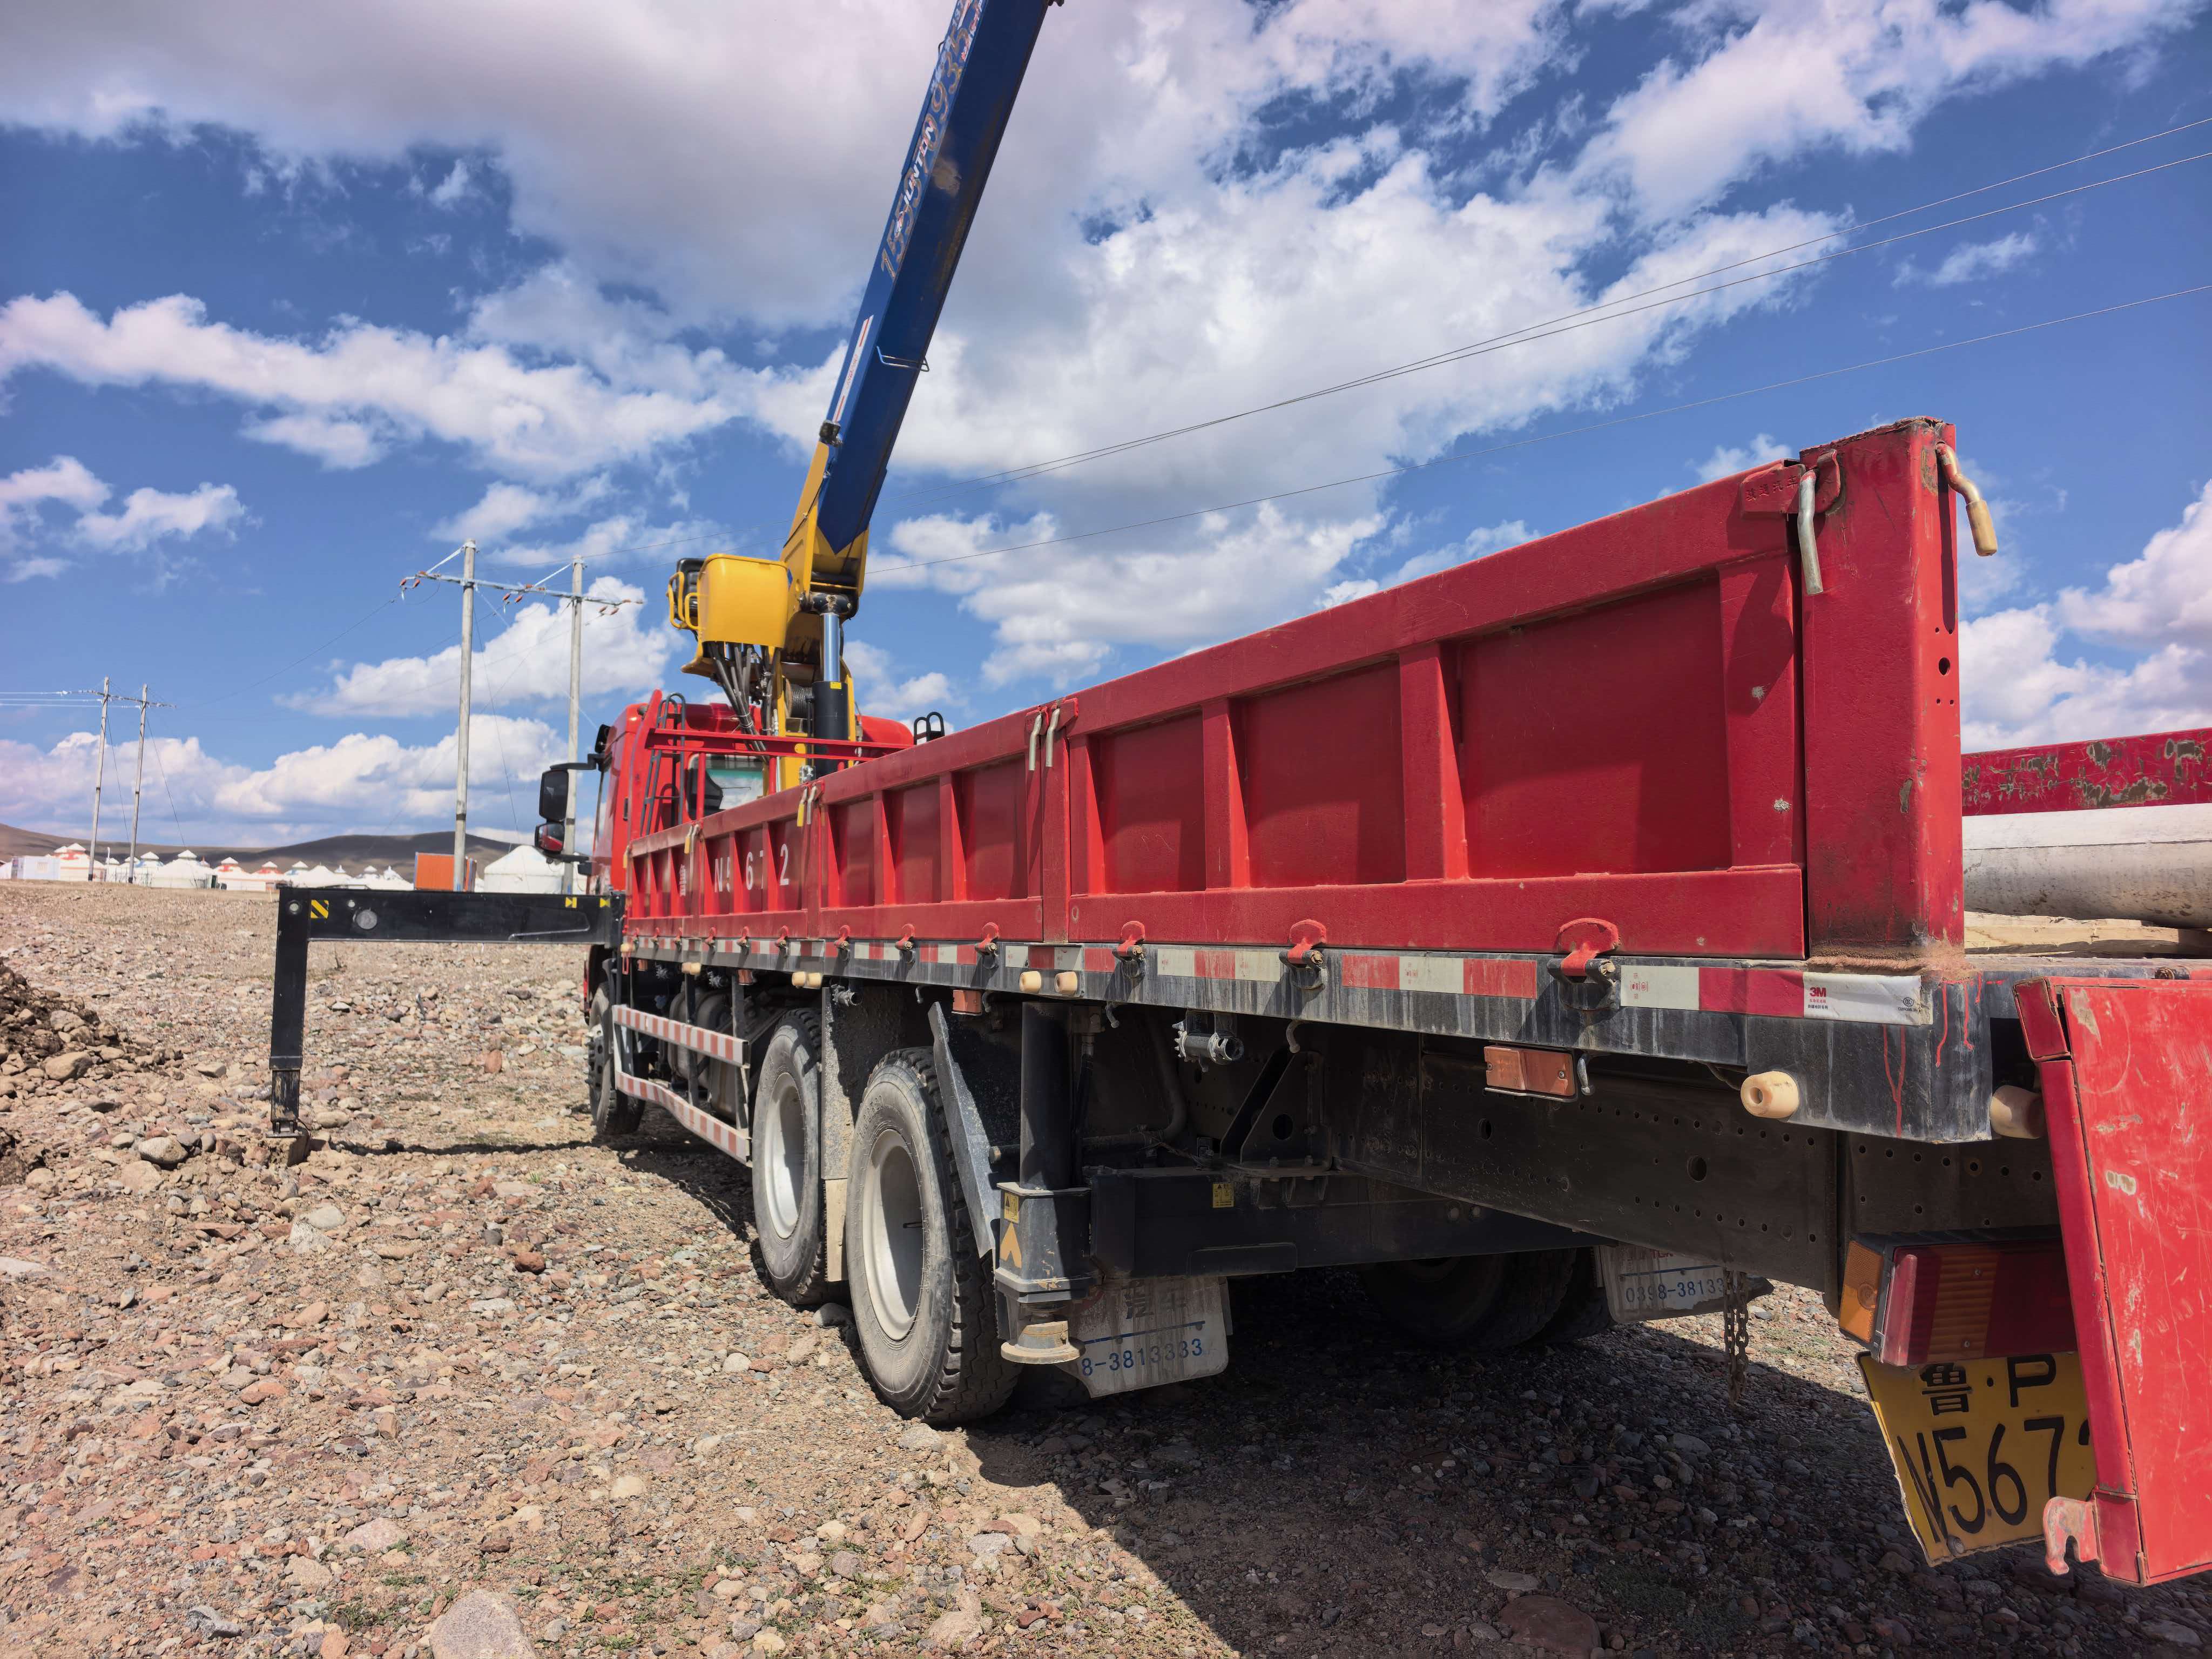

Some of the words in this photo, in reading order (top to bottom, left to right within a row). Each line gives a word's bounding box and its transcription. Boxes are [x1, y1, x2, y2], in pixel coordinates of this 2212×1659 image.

[1810, 987, 1826, 997] 3M
[1625, 1277, 1738, 1303] 0398-38133
[1896, 1416, 2090, 1543] N567
